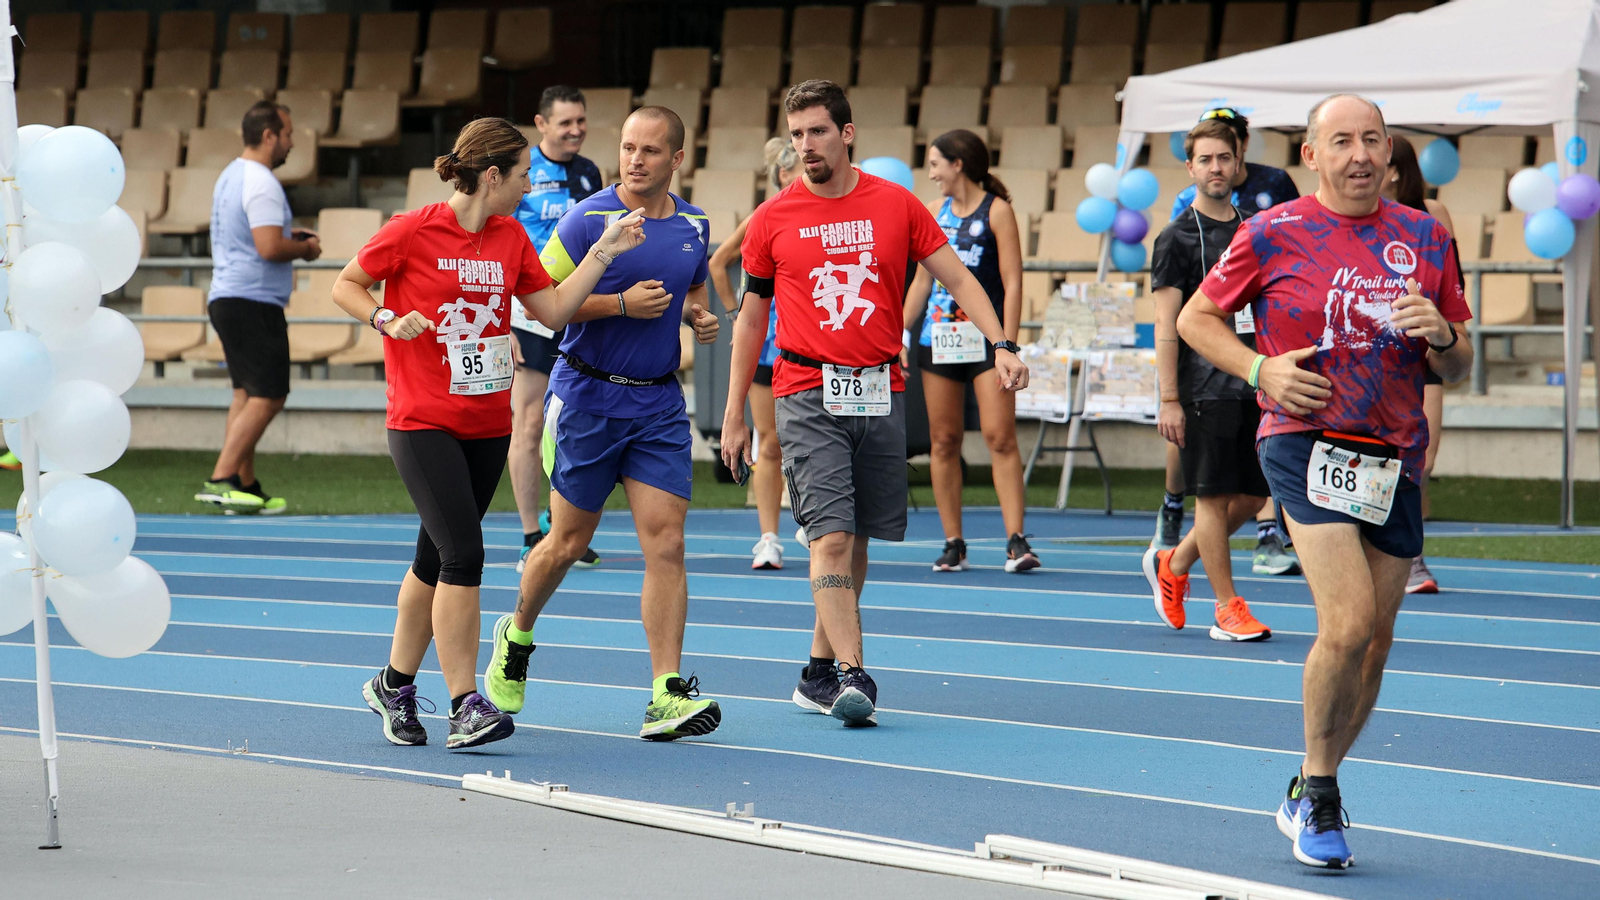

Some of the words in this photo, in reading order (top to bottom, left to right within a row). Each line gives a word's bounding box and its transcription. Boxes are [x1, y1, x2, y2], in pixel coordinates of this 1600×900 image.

[1270, 215, 1302, 225] TEAMERGY
[799, 226, 819, 239] XLII
[819, 219, 873, 236] CARRERA
[821, 230, 874, 248] POPULAR
[849, 244, 857, 253] DE
[437, 258, 456, 270] XLII
[457, 258, 503, 274] CARRERA
[458, 270, 504, 285] POPULAR
[1332, 267, 1358, 287] IV
[1351, 275, 1383, 290] Trail
[1384, 275, 1422, 291] urbo
[1368, 290, 1399, 300] Ciudad
[934, 334, 963, 348] 1032
[462, 354, 483, 376] 95
[831, 378, 862, 396] 978
[1319, 464, 1357, 492] 168
